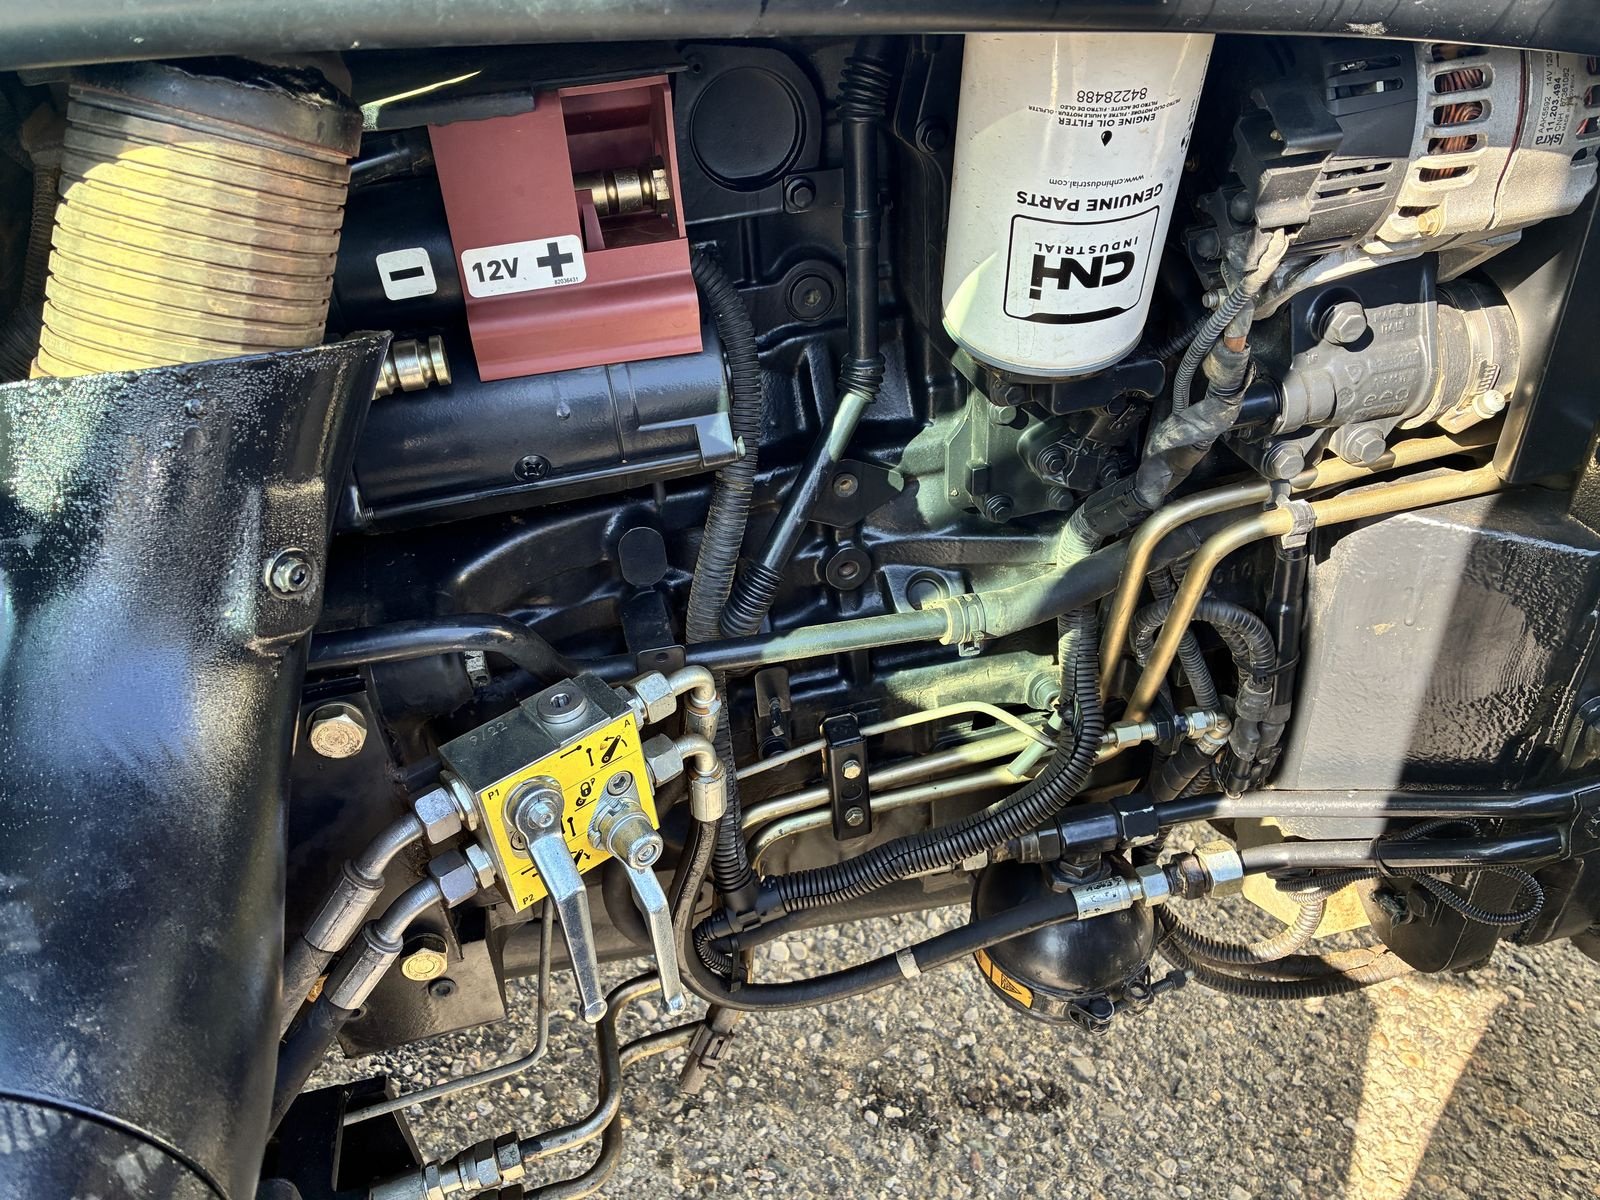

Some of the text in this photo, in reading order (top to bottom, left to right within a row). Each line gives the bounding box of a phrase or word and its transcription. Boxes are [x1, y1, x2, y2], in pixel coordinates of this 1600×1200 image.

[1077, 87, 1148, 103] 84228488
[1058, 113, 1156, 127] ENGINE OIL FILTER
[1554, 112, 1564, 132] CNH
[1535, 132, 1565, 146] Iskra
[1049, 174, 1144, 189] www.cnhindustrial.com
[1016, 183, 1163, 211] GENUINE PARTS
[1034, 236, 1138, 255] INDUSTRIAL
[472, 257, 519, 283] 12V
[623, 719, 631, 728] A
[487, 789, 500, 800] P1
[522, 893, 535, 905] P2
